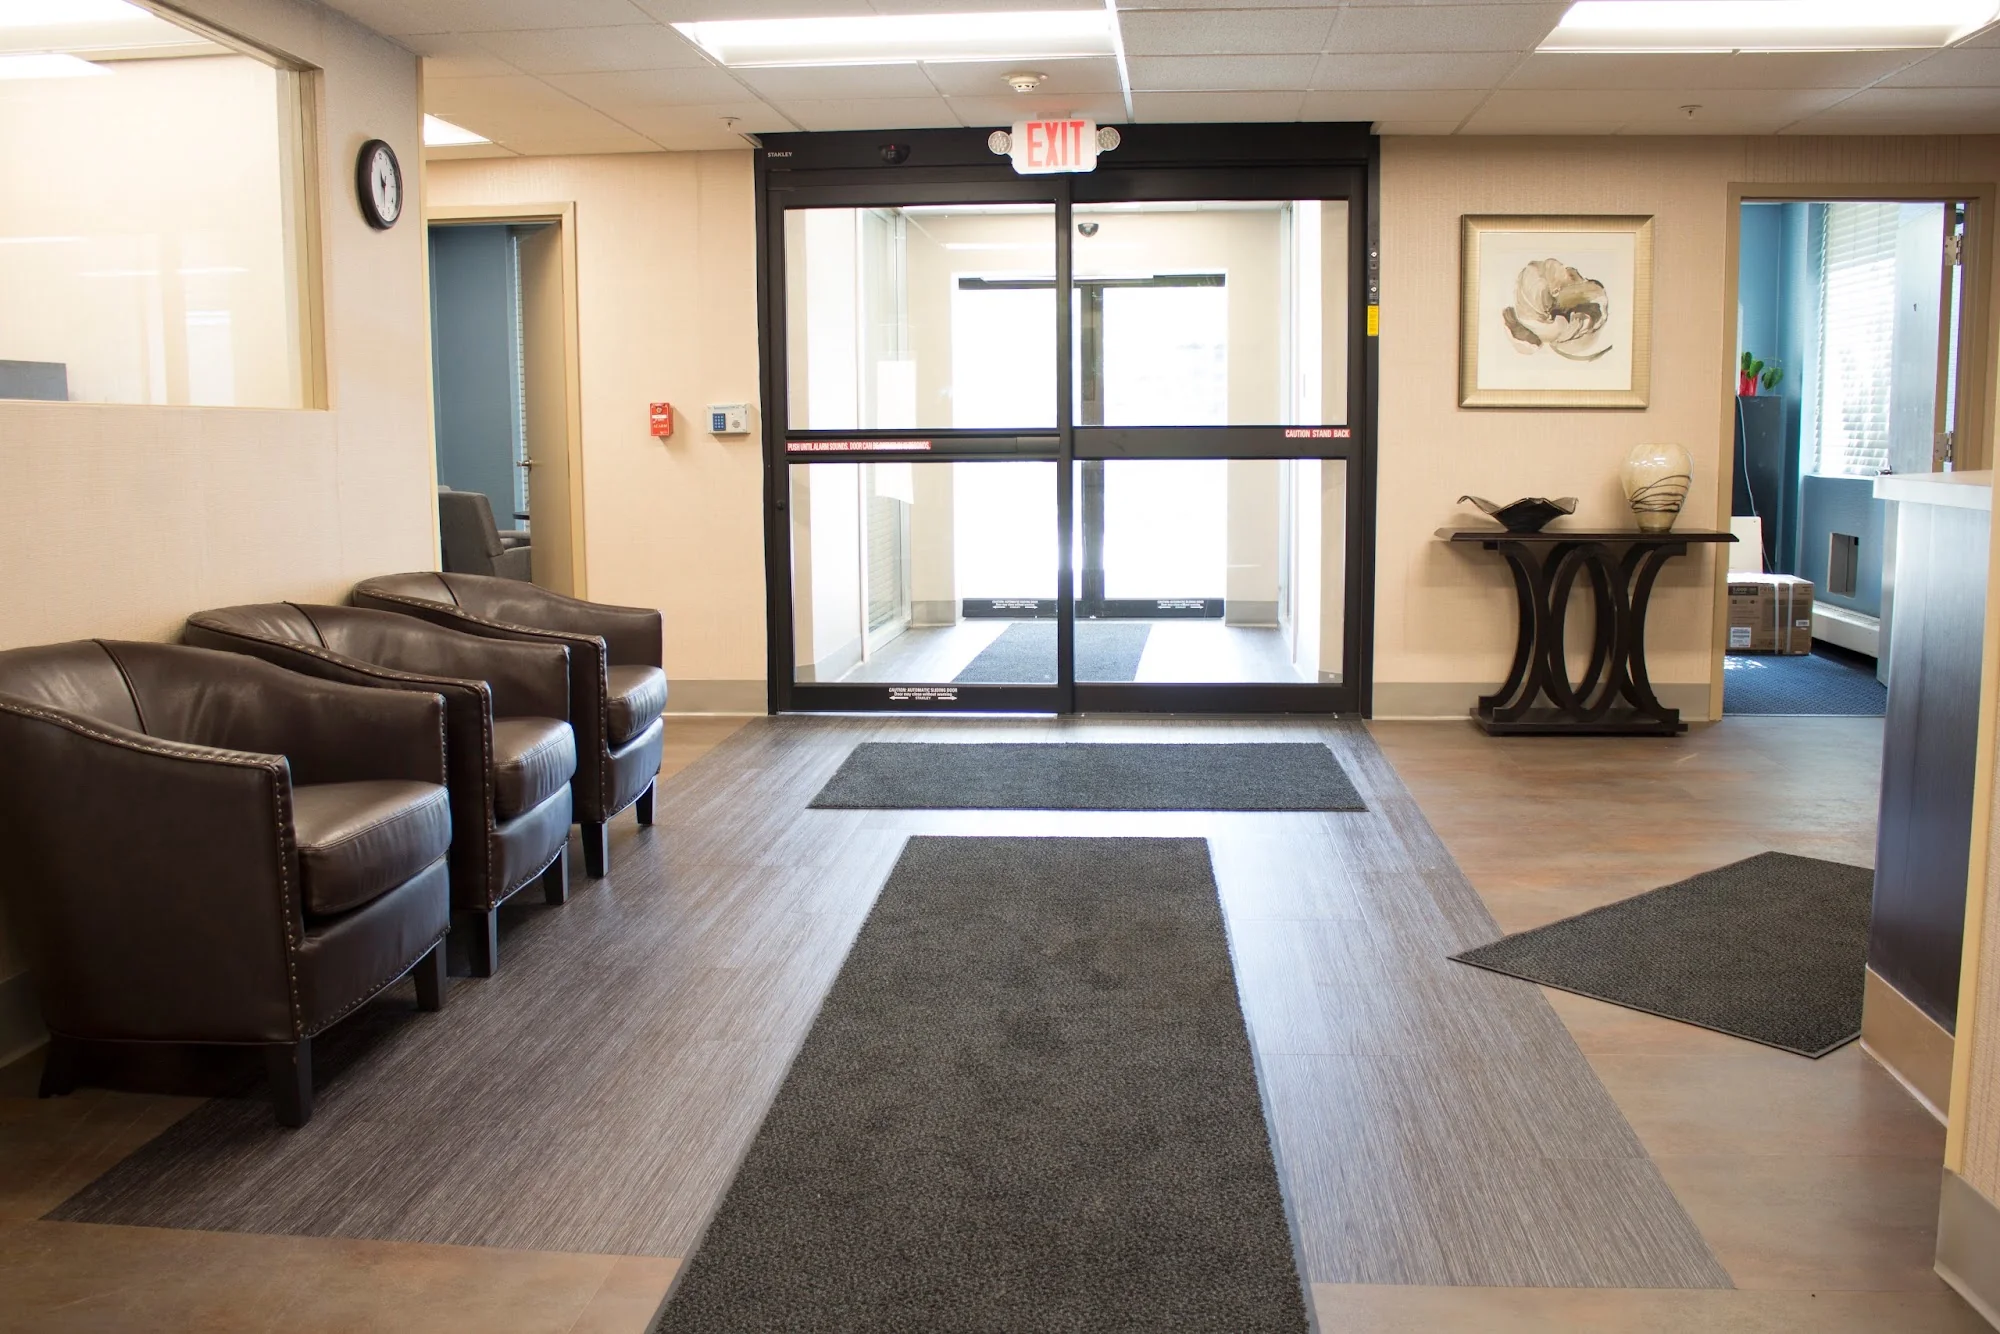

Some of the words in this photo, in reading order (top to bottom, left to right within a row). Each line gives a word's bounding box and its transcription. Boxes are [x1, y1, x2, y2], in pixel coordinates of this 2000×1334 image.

[1027, 121, 1085, 167] EXIT
[1285, 429, 1310, 438] CAUTION
[1312, 429, 1332, 438] STAND
[1333, 429, 1350, 438] BACK
[787, 443, 800, 451] PUSH
[801, 442, 813, 451] UNTIL
[813, 442, 829, 451] ALARM
[850, 441, 862, 451] DOOR
[862, 441, 873, 450] CAN
